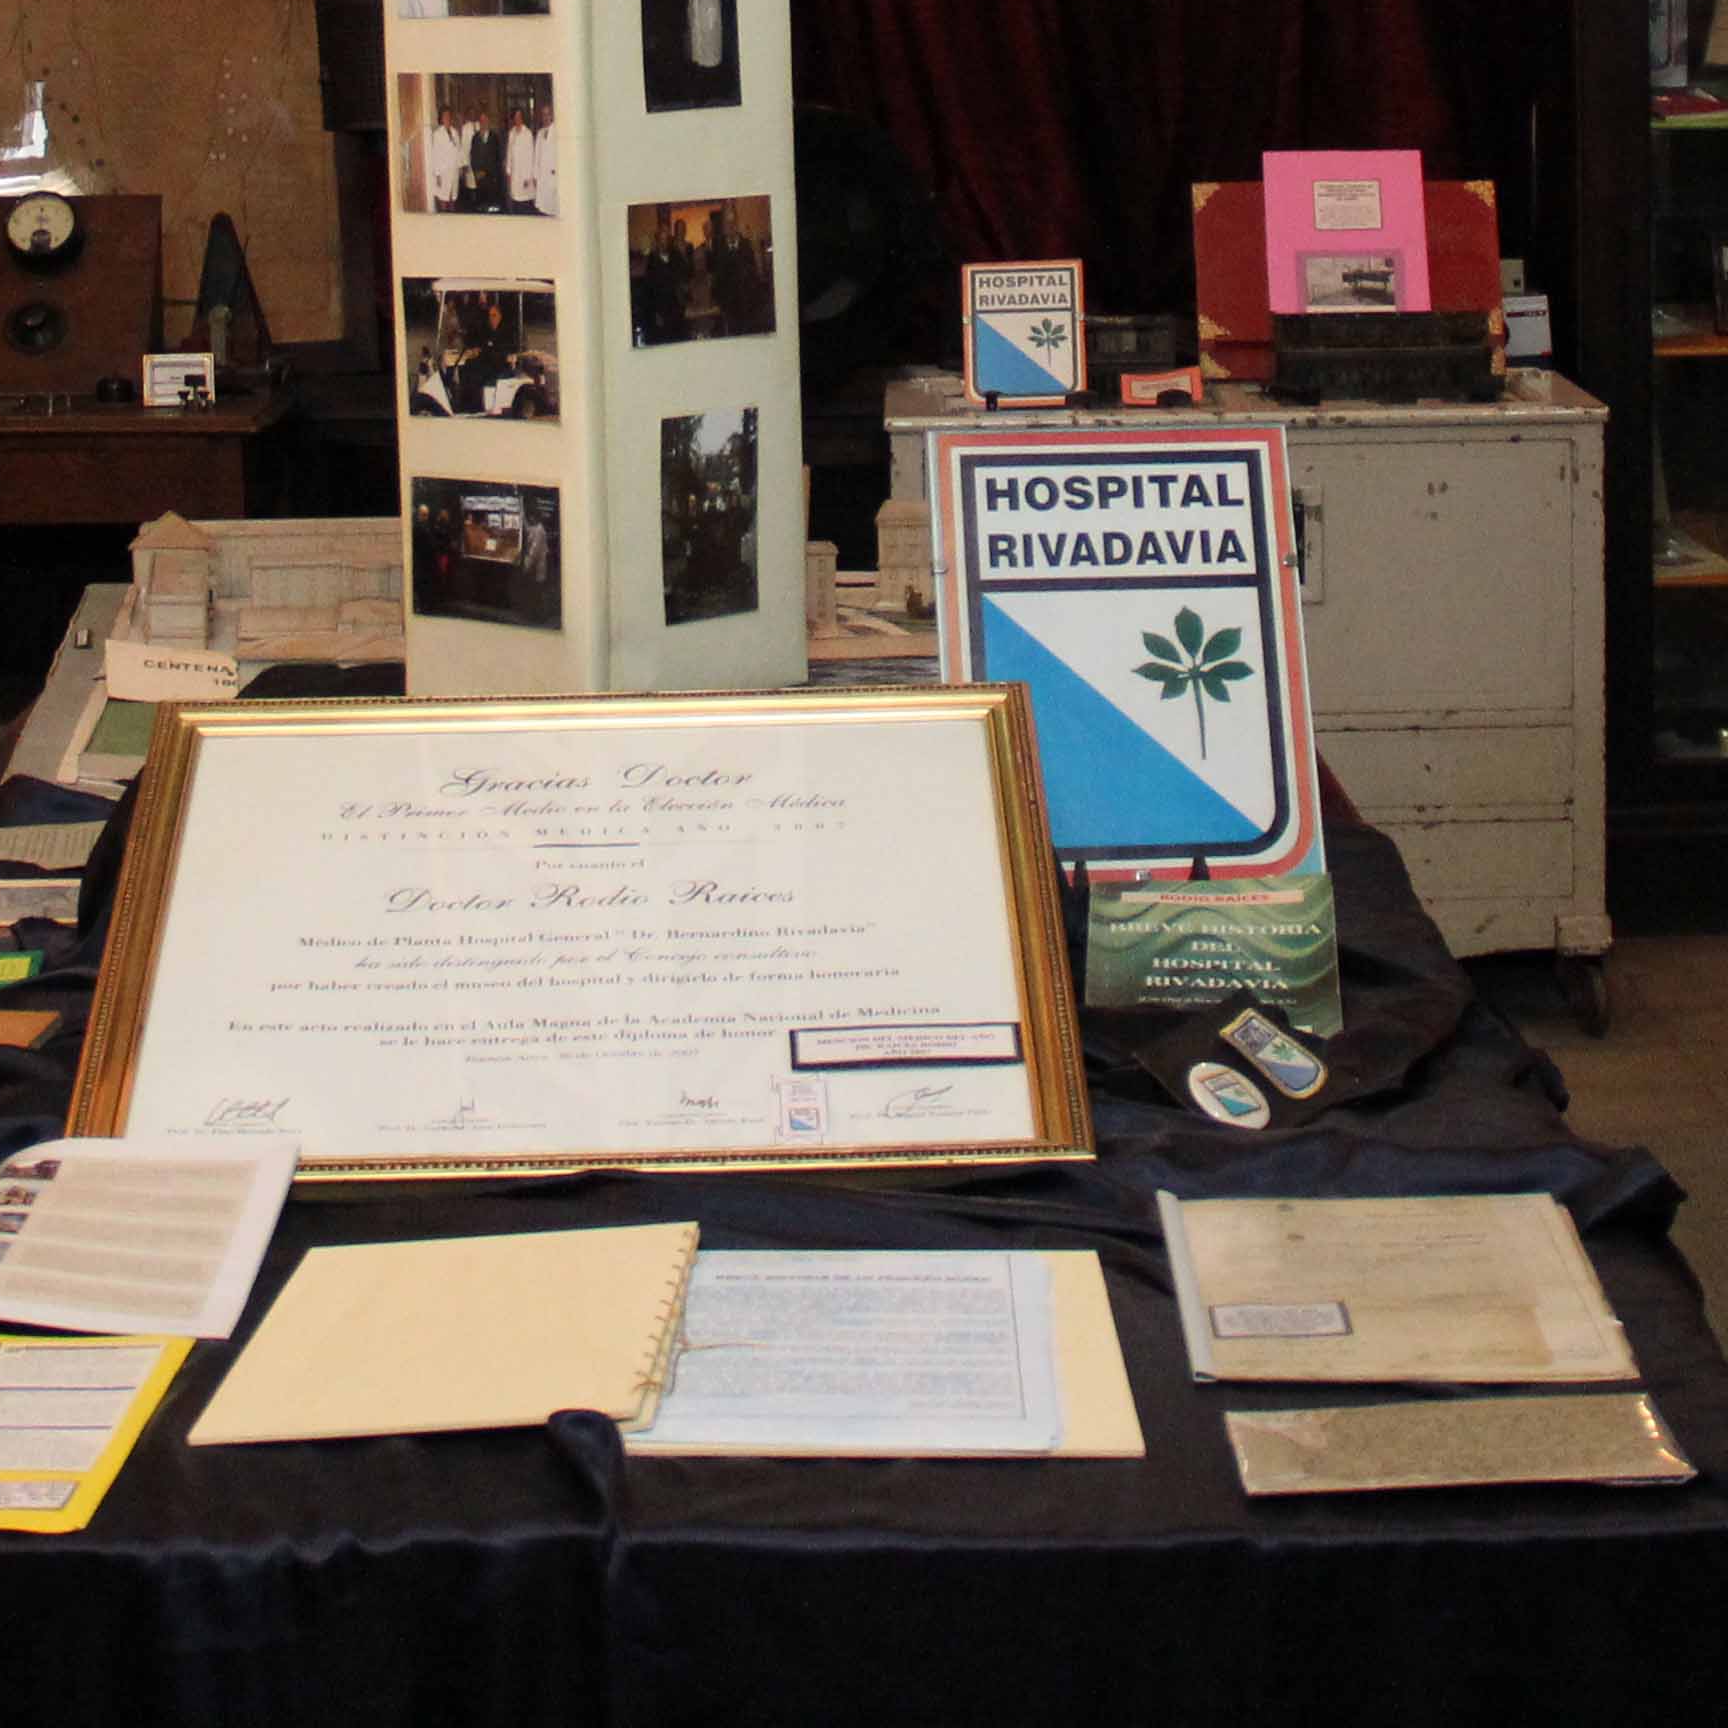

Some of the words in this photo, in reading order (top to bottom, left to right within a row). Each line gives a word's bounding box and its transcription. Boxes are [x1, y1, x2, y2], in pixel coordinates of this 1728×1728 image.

[978, 275, 1068, 288] HOSPITAL
[979, 293, 1069, 306] RIVADAVIA
[985, 473, 1245, 512] HOSPITAL
[987, 528, 1248, 570] RIVADAVIA
[143, 659, 239, 677] CENTENA
[439, 767, 592, 796] Gracias
[618, 763, 753, 789] Doctor
[383, 887, 515, 913] Doctor
[529, 879, 650, 909] Rodio
[1201, 923, 1322, 935] HISTORIA
[1191, 941, 1239, 952] DEL
[1152, 957, 1280, 972] HOSPITAL
[1145, 975, 1289, 991] RIVADAVIA
